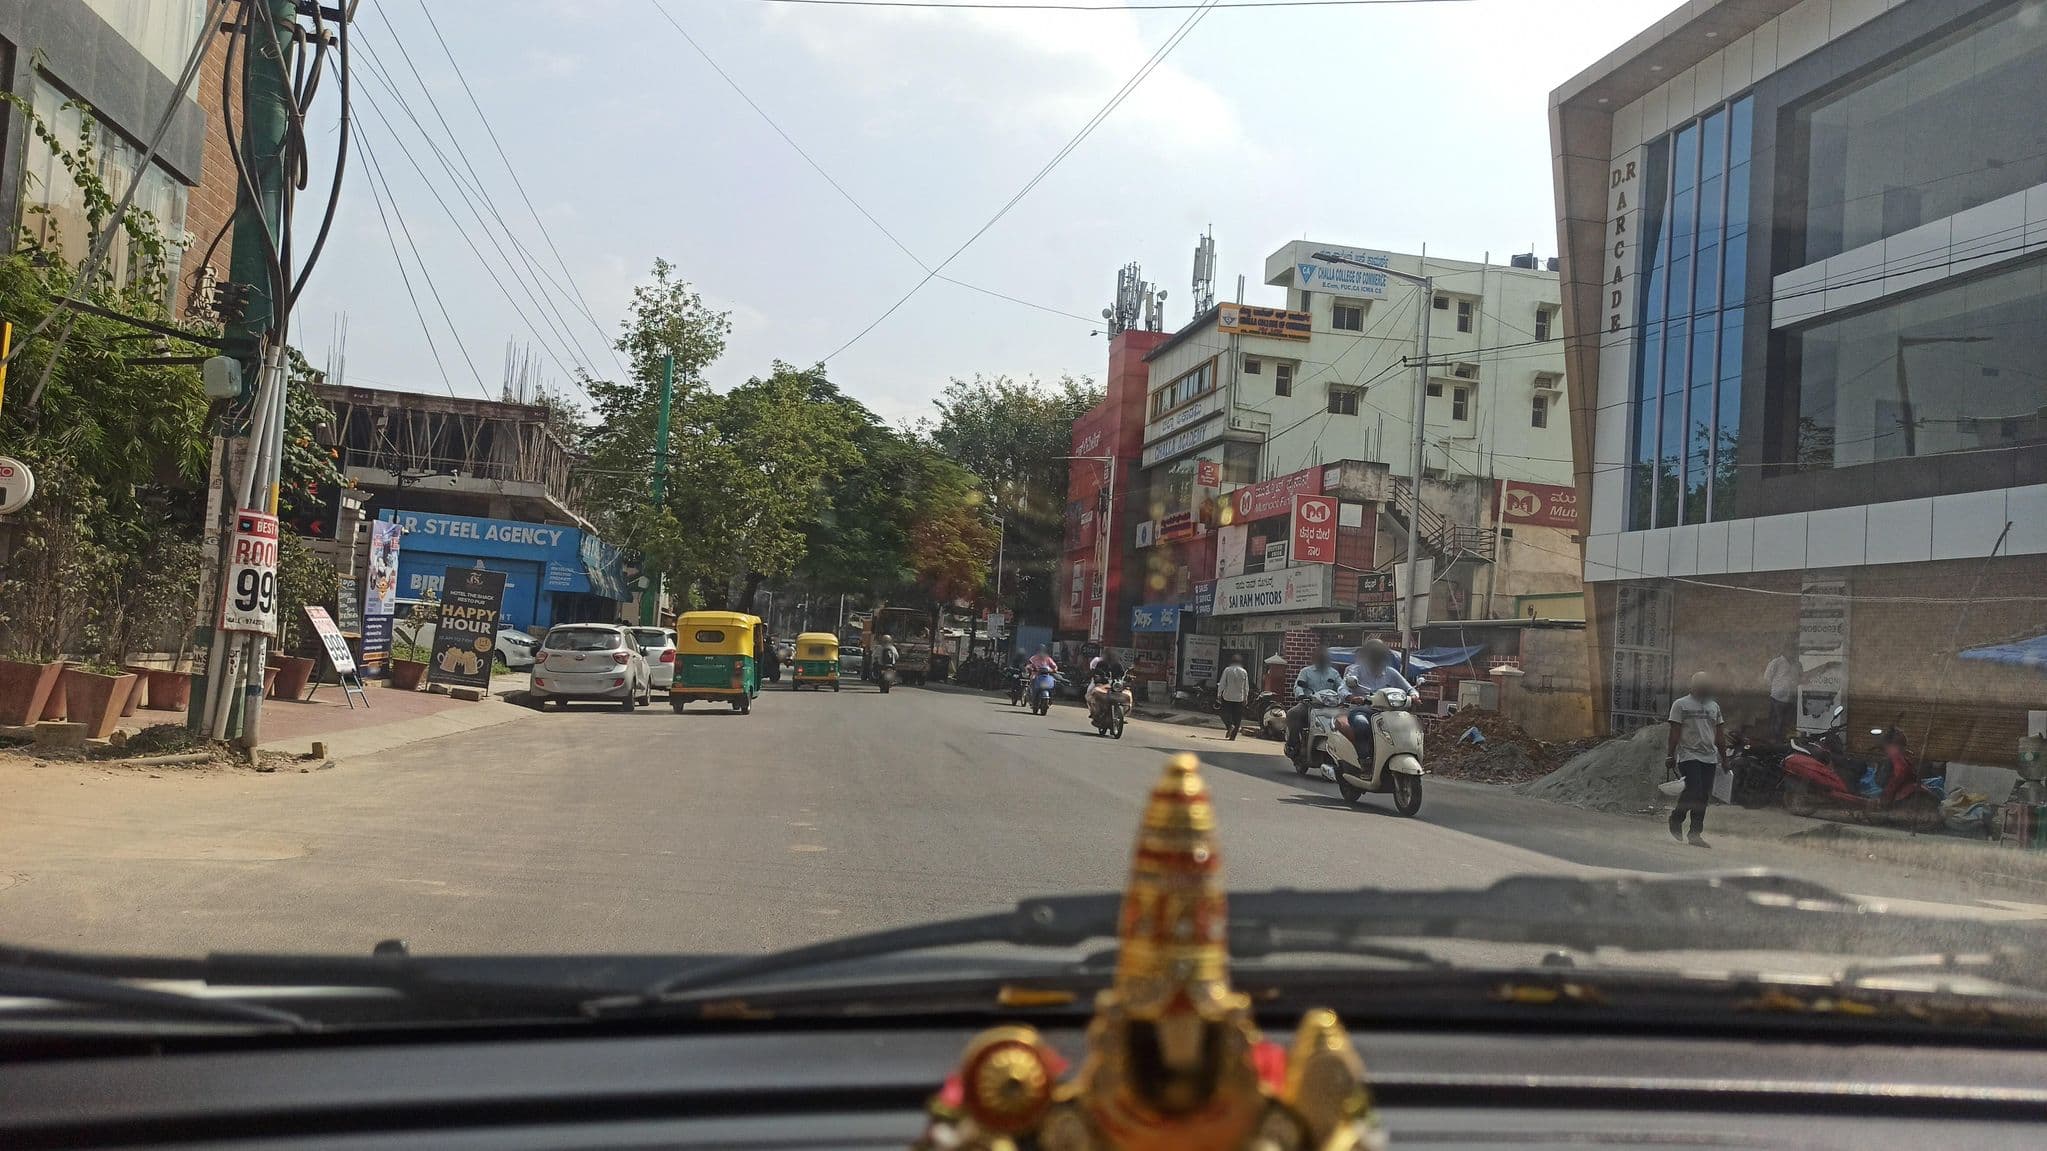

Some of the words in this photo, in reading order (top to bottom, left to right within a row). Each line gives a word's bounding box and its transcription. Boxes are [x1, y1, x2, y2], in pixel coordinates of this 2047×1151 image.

[1611, 161, 1636, 189] D.R
[1610, 191, 1627, 334] ARCADE
[1318, 267, 1335, 282] CHALLA
[1336, 268, 1355, 284] COLLEGE
[1356, 271, 1362, 284] OF
[1362, 272, 1387, 287] COMMERCE
[1177, 424, 1208, 451] ACADEMY
[257, 521, 274, 534] BEST
[424, 518, 480, 540] STEEL
[484, 524, 563, 547] AGENCY
[235, 540, 277, 568] ROO
[442, 603, 497, 622] HAPPY
[1229, 595, 1239, 609] SAI
[1239, 593, 1253, 607] RAM
[1254, 590, 1282, 606] MOTORS
[441, 617, 491, 635] HOUR
[323, 634, 350, 662] 999
